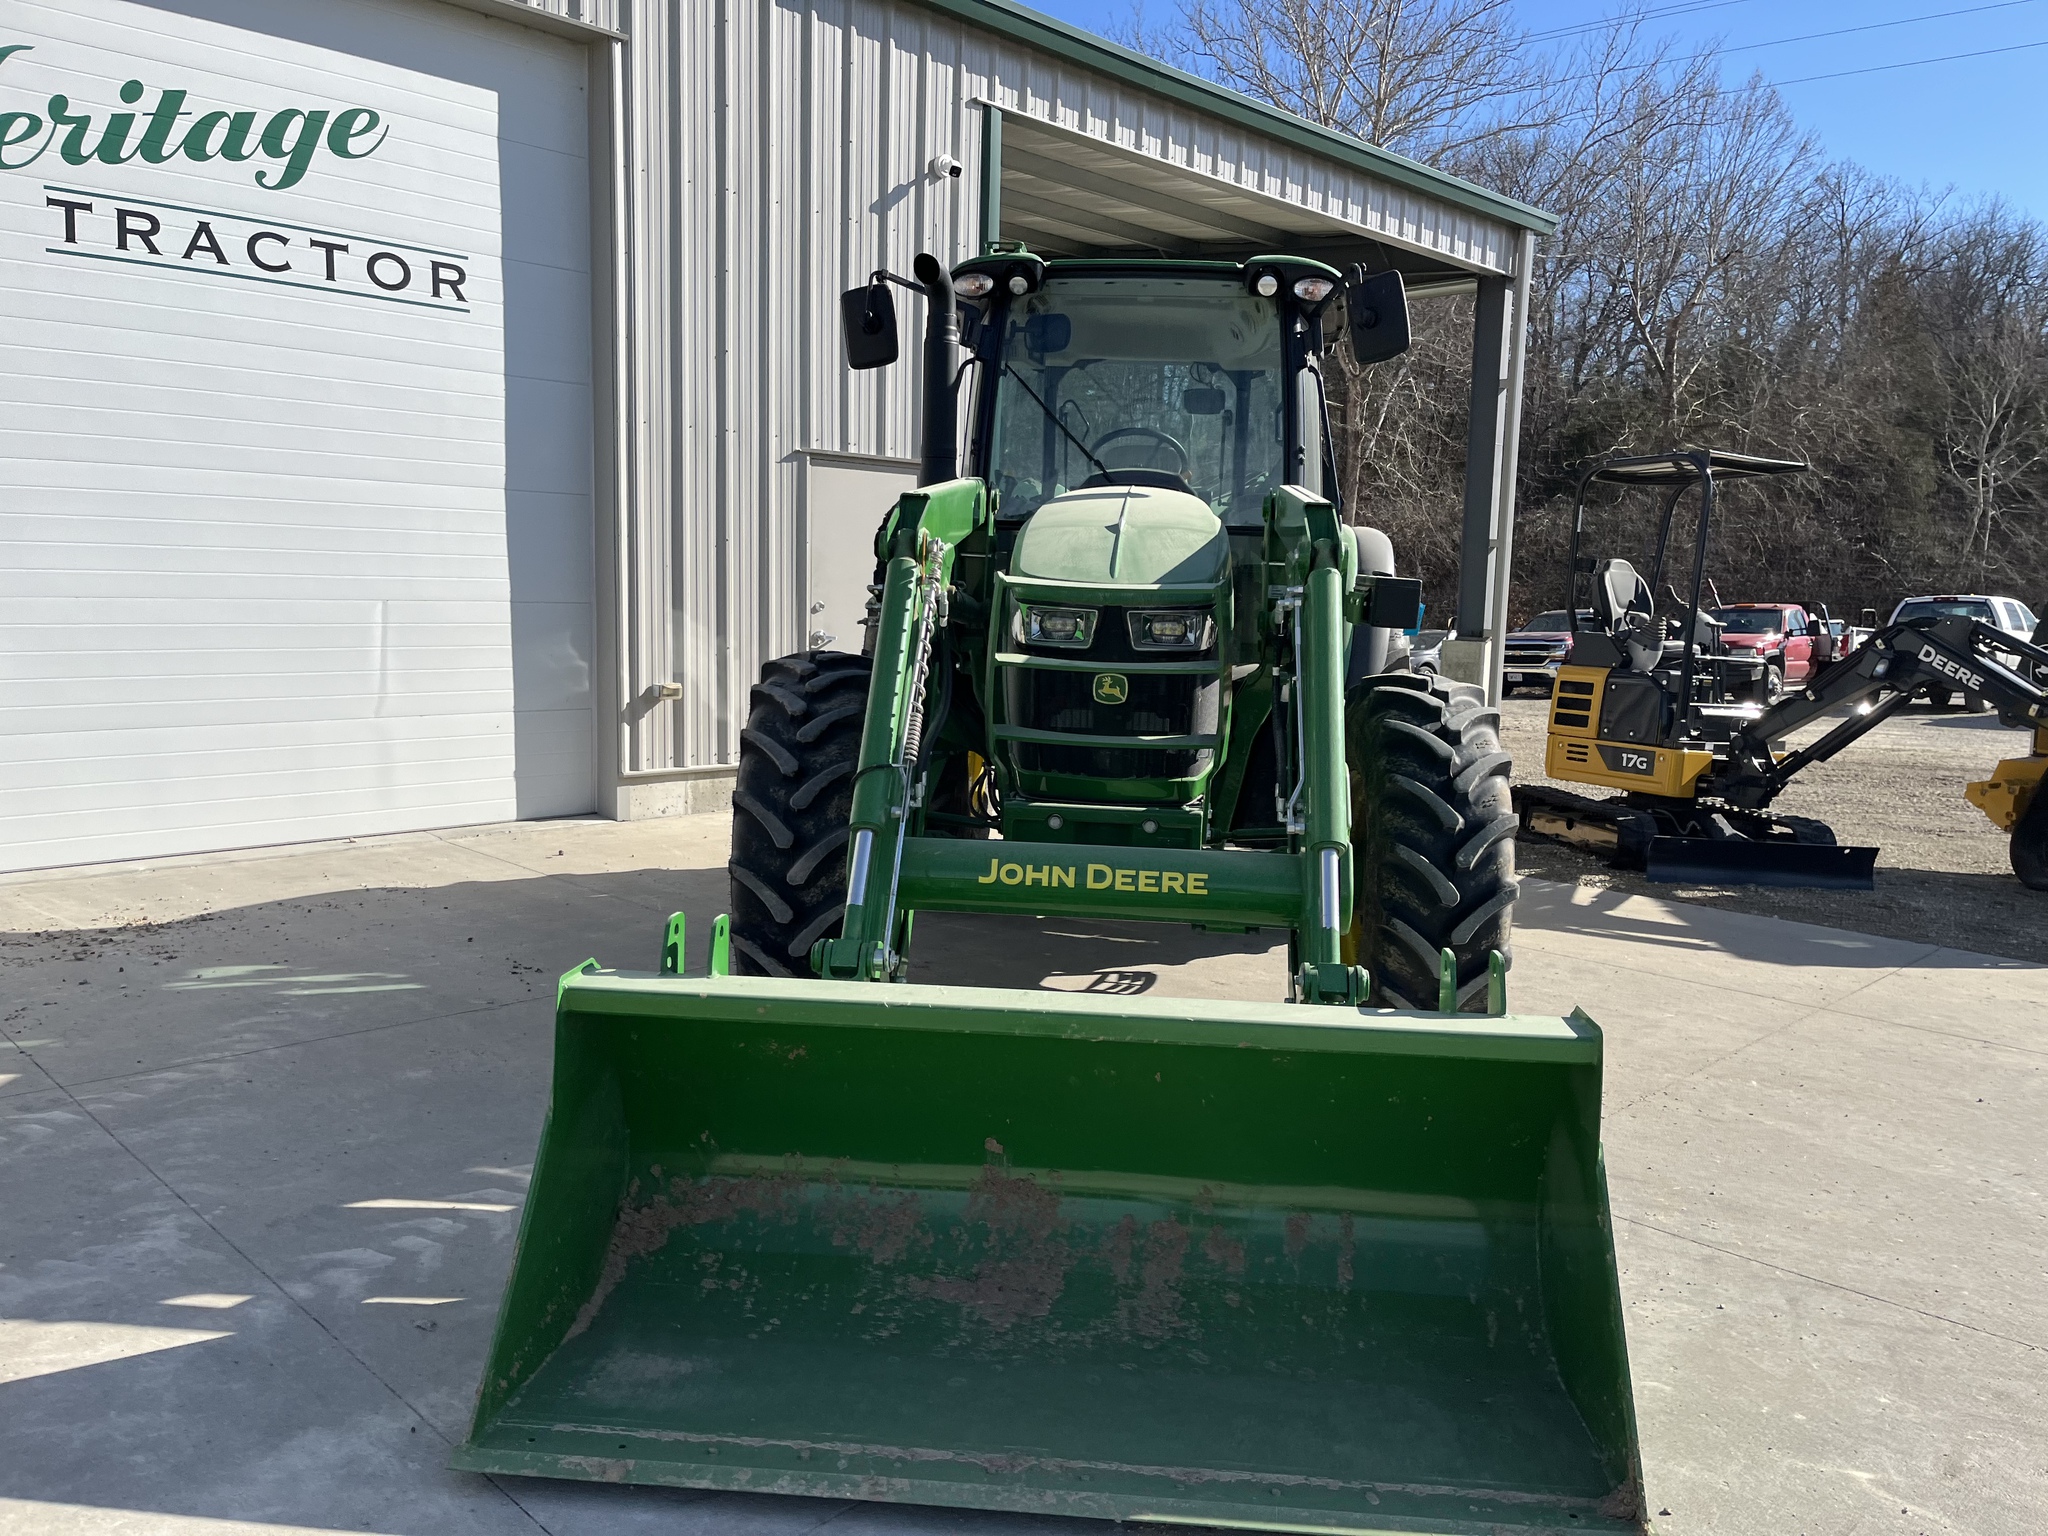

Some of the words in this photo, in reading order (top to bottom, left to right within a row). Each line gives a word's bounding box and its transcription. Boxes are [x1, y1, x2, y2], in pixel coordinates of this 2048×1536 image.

[0, 45, 390, 190] eritage
[46, 195, 469, 303] TRACTOR
[1917, 644, 1985, 691] DEERE
[1621, 753, 1648, 770] 17G
[978, 858, 1076, 889] JOHN
[1086, 863, 1209, 895] DEERE
